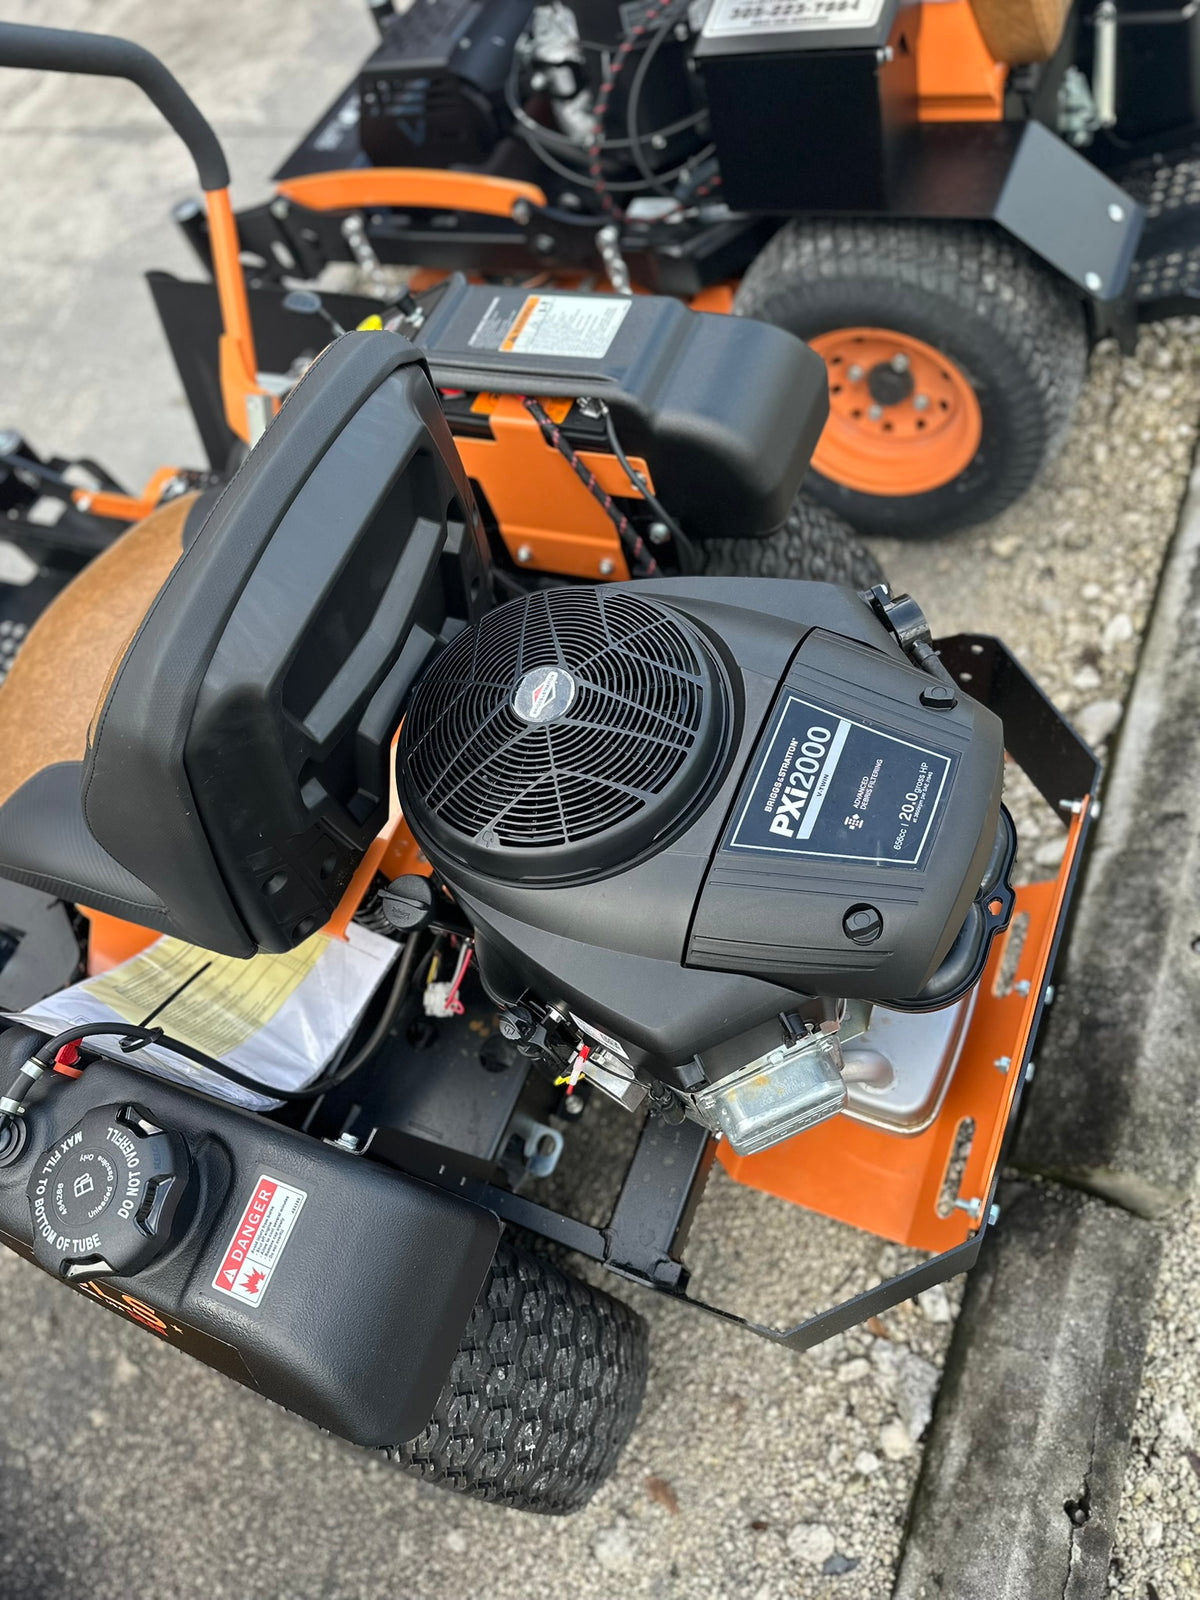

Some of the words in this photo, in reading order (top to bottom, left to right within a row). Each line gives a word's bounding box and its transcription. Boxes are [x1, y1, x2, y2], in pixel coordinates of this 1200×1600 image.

[919, 762, 928, 774] HP
[769, 726, 831, 838] PXi2000
[817, 774, 830, 797] V-TWIN
[853, 776, 869, 809] ADVANCED
[860, 788, 873, 810] DEBRIS
[868, 759, 883, 789] FILTERING
[914, 774, 926, 794] gross
[899, 792, 918, 821] 20.0
[893, 828, 907, 850] 656cc
[60, 1131, 83, 1153] MAX
[106, 1127, 140, 1168] OVERFILL
[42, 1150, 62, 1174] FILL
[79, 1153, 94, 1162] Only
[97, 1155, 114, 1182] Gasoline
[36, 1178, 48, 1195] TO
[126, 1171, 141, 1196] NOT
[88, 1186, 113, 1218] Unleaded
[117, 1200, 134, 1219] DO
[34, 1198, 57, 1244] BOTTOM
[230, 1189, 272, 1262] DANGER
[56, 1236, 71, 1251] OF
[72, 1233, 101, 1253] TUBE
